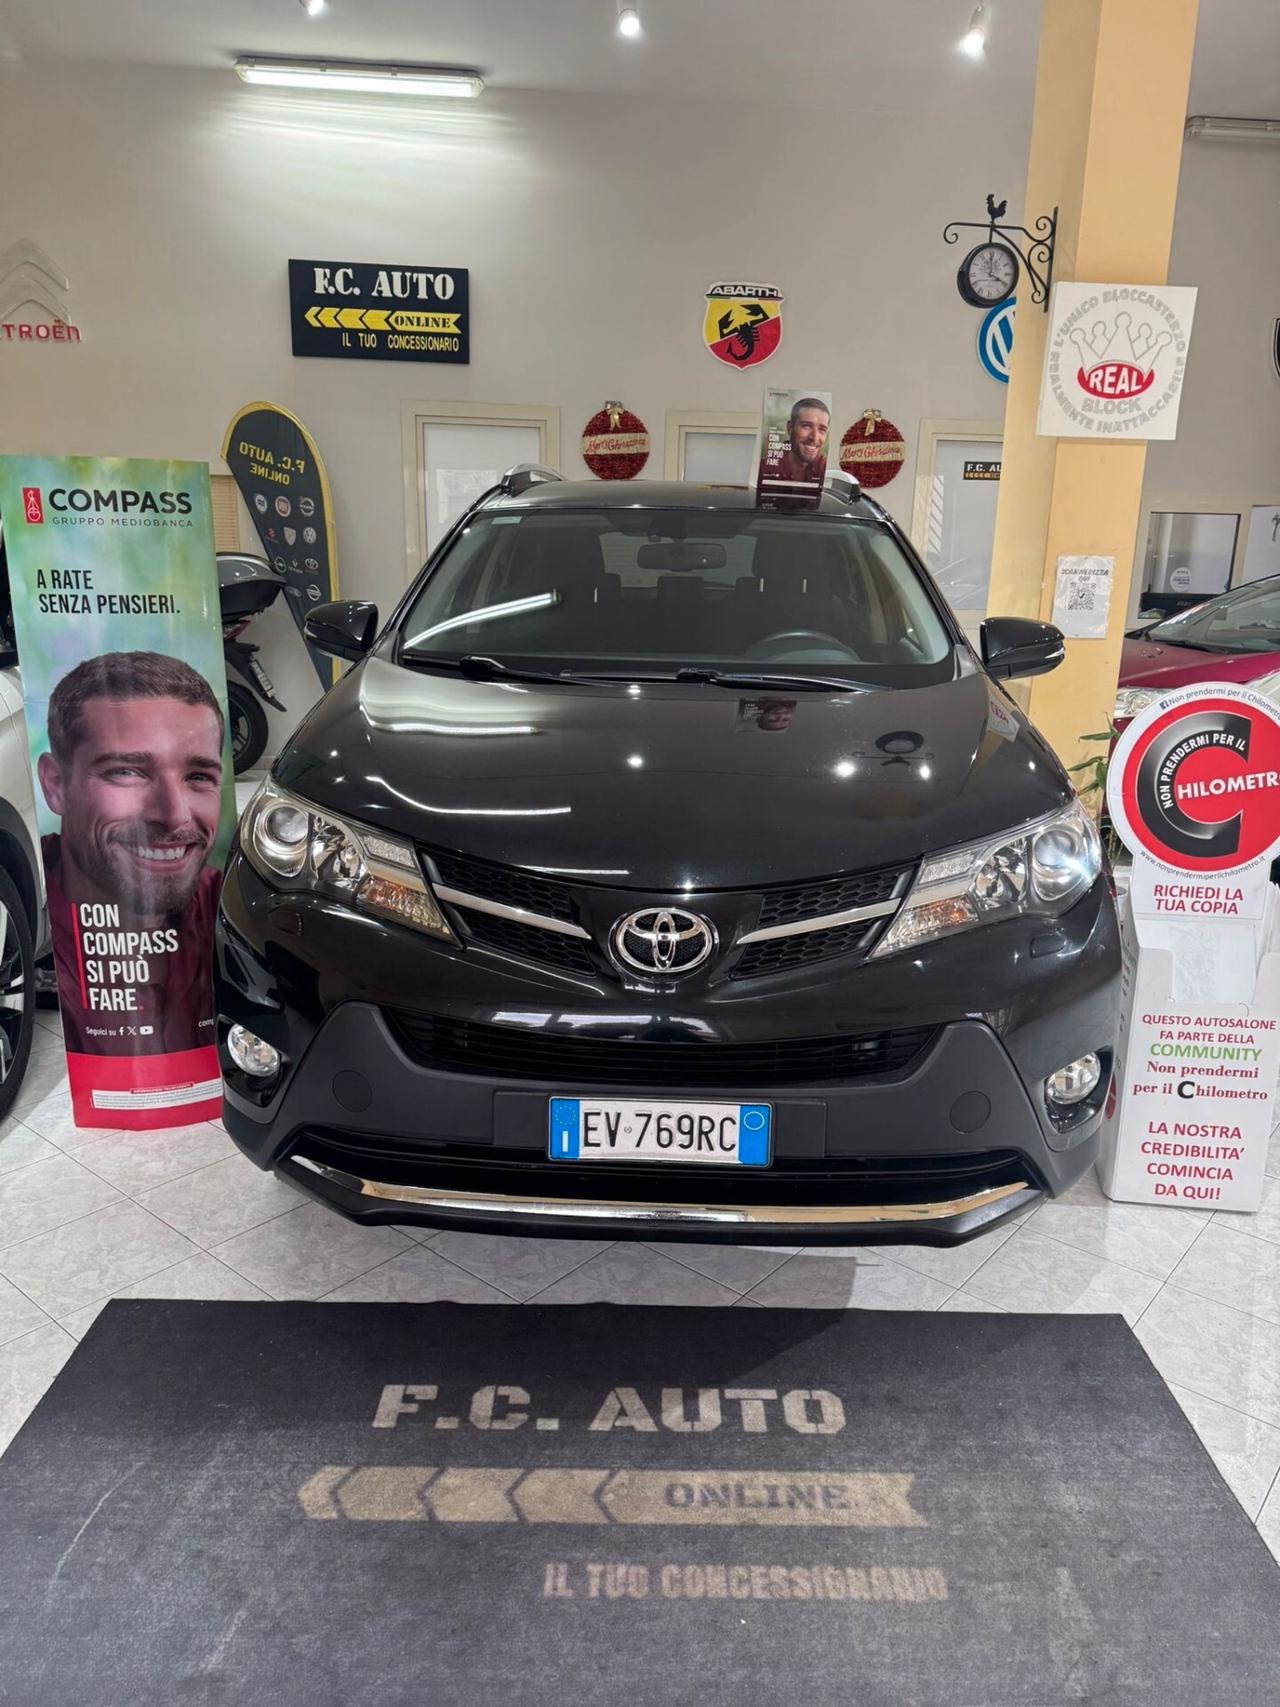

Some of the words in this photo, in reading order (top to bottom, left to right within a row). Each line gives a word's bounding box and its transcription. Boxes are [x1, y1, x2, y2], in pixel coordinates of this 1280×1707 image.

[313, 267, 361, 296] F.C.
[371, 270, 455, 300] AUTO
[711, 285, 778, 297] ABARTH
[1, 319, 82, 343] TROËN
[394, 314, 451, 328] ONLINE
[342, 332, 352, 347] IL
[358, 333, 377, 348] TUO
[387, 334, 459, 351] CONCESSIONARIO
[1088, 365, 1143, 395] REAL
[1081, 397, 1142, 415] BLOCK
[48, 488, 193, 514] COMPASS
[52, 516, 105, 527] GRUPPO
[111, 517, 194, 528] MEDIOBANCA
[37, 568, 48, 590] A
[51, 569, 94, 591] RATE
[39, 593, 93, 614] SENZA
[96, 594, 182, 615] PENSIERI.
[1167, 693, 1186, 707] Non
[1185, 687, 1226, 701] prendermi
[1229, 687, 1242, 698] per
[1213, 733, 1234, 747] PER
[1235, 738, 1247, 751] IL
[1161, 733, 1210, 783] PRENDERMI
[1176, 770, 1280, 800] HILOMETR
[1161, 784, 1174, 810] NON
[1153, 884, 1220, 901] RICHIEDI
[1224, 887, 1244, 901] LA
[79, 903, 120, 928] CON
[1155, 899, 1187, 912] TUA
[1190, 900, 1239, 915] COPIA
[82, 929, 179, 956] COMPASS
[86, 959, 105, 984] SI
[109, 954, 150, 984] PUÒ
[86, 1026, 108, 1037] Seguici
[108, 1028, 117, 1036] su
[1142, 1014, 1191, 1027] QUESTO
[1193, 1016, 1277, 1031] AUTOSALONE
[1159, 1030, 1175, 1041] FA
[1177, 1030, 1215, 1042] PARTE
[1217, 1033, 1256, 1045] DELLA
[1149, 1043, 1263, 1062] COMMUNITY
[1147, 1060, 1177, 1073] Non
[1180, 1063, 1260, 1080] prendermi
[1133, 1082, 1158, 1097] per
[1161, 1082, 1173, 1094] il
[1176, 1080, 1269, 1101] Chilometro
[1148, 1120, 1168, 1134] LA
[1173, 1122, 1242, 1140] NOSTRA
[1146, 1161, 1234, 1181] COMINCIA
[1154, 1182, 1178, 1198] DA
[1181, 1184, 1221, 1201] QUI!
[371, 1383, 560, 1431] F.C.
[587, 1386, 847, 1435] AUTO
[664, 1482, 852, 1511] ONLINE
[543, 1563, 575, 1599] IL
[586, 1563, 651, 1600] TUO
